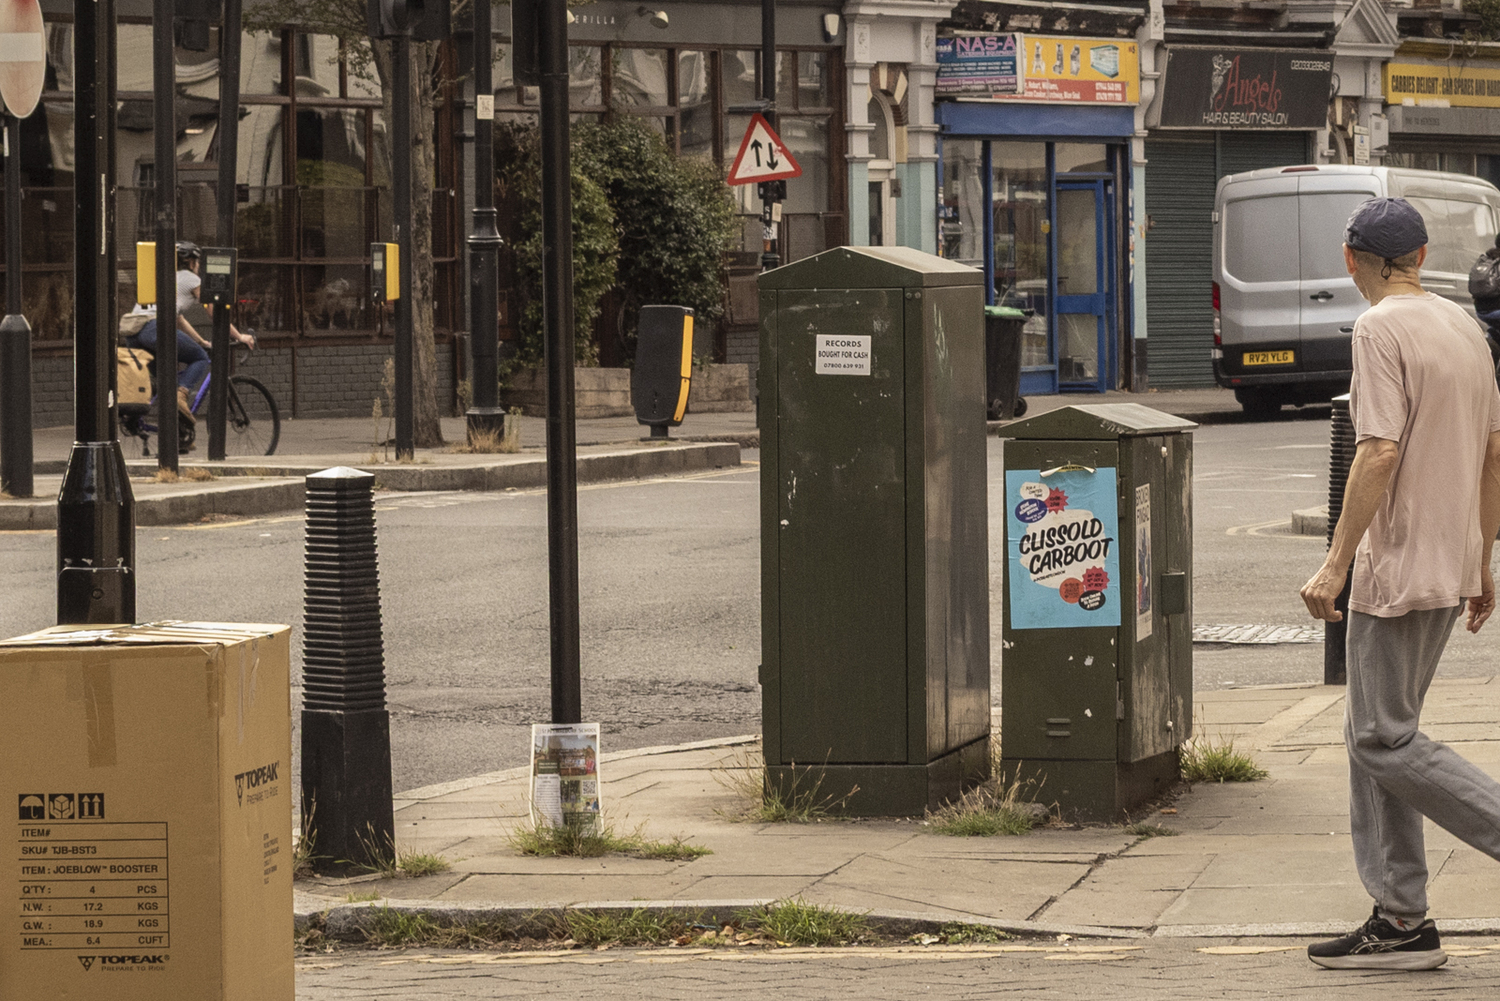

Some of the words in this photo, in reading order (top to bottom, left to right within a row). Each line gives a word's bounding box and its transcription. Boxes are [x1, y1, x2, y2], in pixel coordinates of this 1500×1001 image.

[575, 14, 615, 25] ERILLA
[1214, 54, 1282, 114] Angels
[1416, 76, 1439, 95] DELIGHT
[1453, 78, 1474, 96] SPARES
[1202, 112, 1222, 124] HAIR
[1222, 112, 1229, 124] &
[1230, 112, 1261, 125] BEAUTY
[1261, 113, 1289, 125] SALON
[825, 340, 862, 348] RECORDS
[818, 350, 840, 358] BOUGHT
[853, 351, 869, 359] CASH
[1248, 353, 1269, 363] RV21
[1270, 351, 1288, 362] YLG
[1019, 518, 1102, 555] CLISSOLD
[1029, 537, 1114, 575] CARBOOT
[245, 761, 278, 789] TOPEAK
[22, 828, 50, 837] ITEM#
[22, 846, 48, 855] SKU#
[51, 846, 97, 855] TJB-BST3
[110, 864, 158, 873] BOOSTER
[89, 886, 95, 894] 4
[137, 886, 157, 894] PCS
[83, 902, 103, 911] 17.2
[137, 902, 158, 910] KGS
[84, 919, 103, 928] 18.9
[138, 919, 159, 927] KGS
[86, 936, 101, 945] 6.4
[138, 935, 164, 944] CUFT
